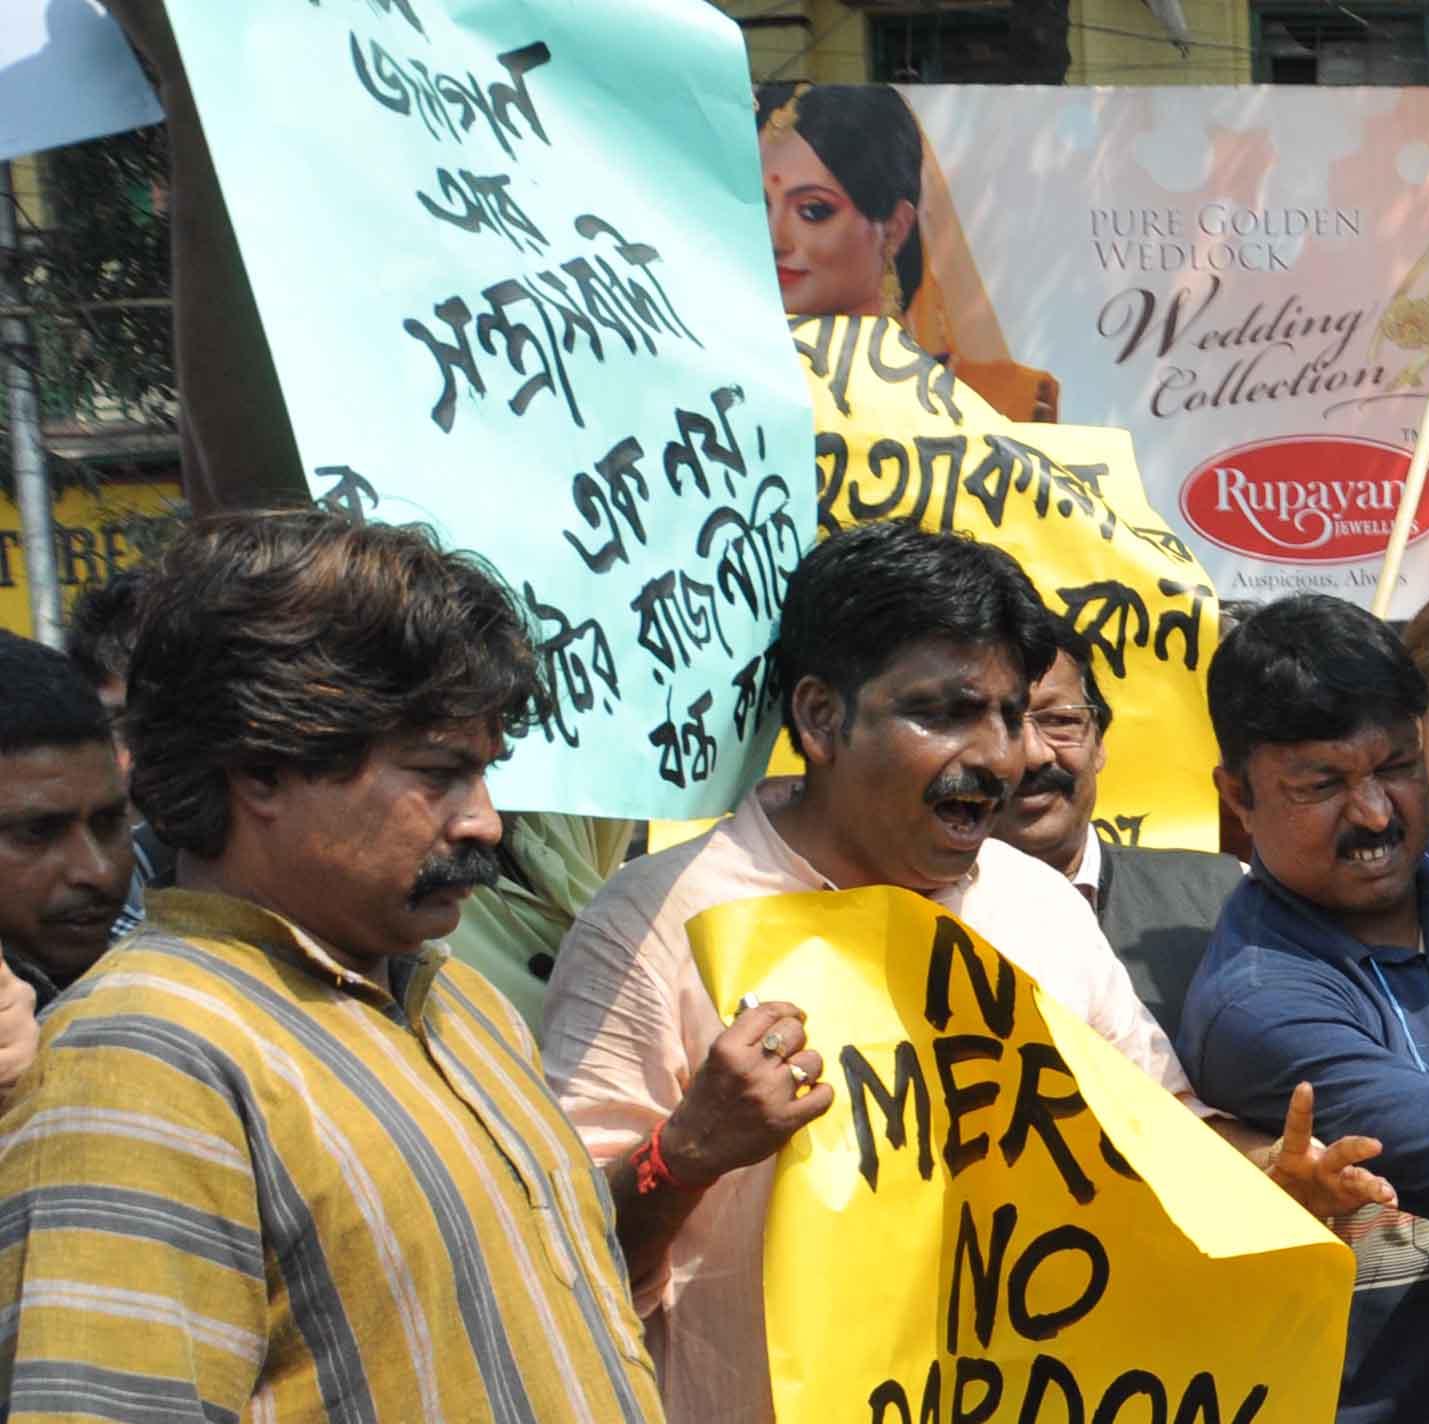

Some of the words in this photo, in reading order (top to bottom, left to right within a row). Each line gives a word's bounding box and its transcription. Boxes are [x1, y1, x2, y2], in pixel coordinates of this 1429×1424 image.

[416, 166, 551, 256] আর
[1090, 207, 1183, 237] PURE
[1198, 203, 1361, 239] GOLDEN
[1094, 239, 1290, 272] WEDLOCK
[1096, 274, 1363, 370] Wedding
[1151, 342, 1386, 418] Collection
[562, 434, 650, 575] এক
[946, 1200, 1110, 1352] NO
